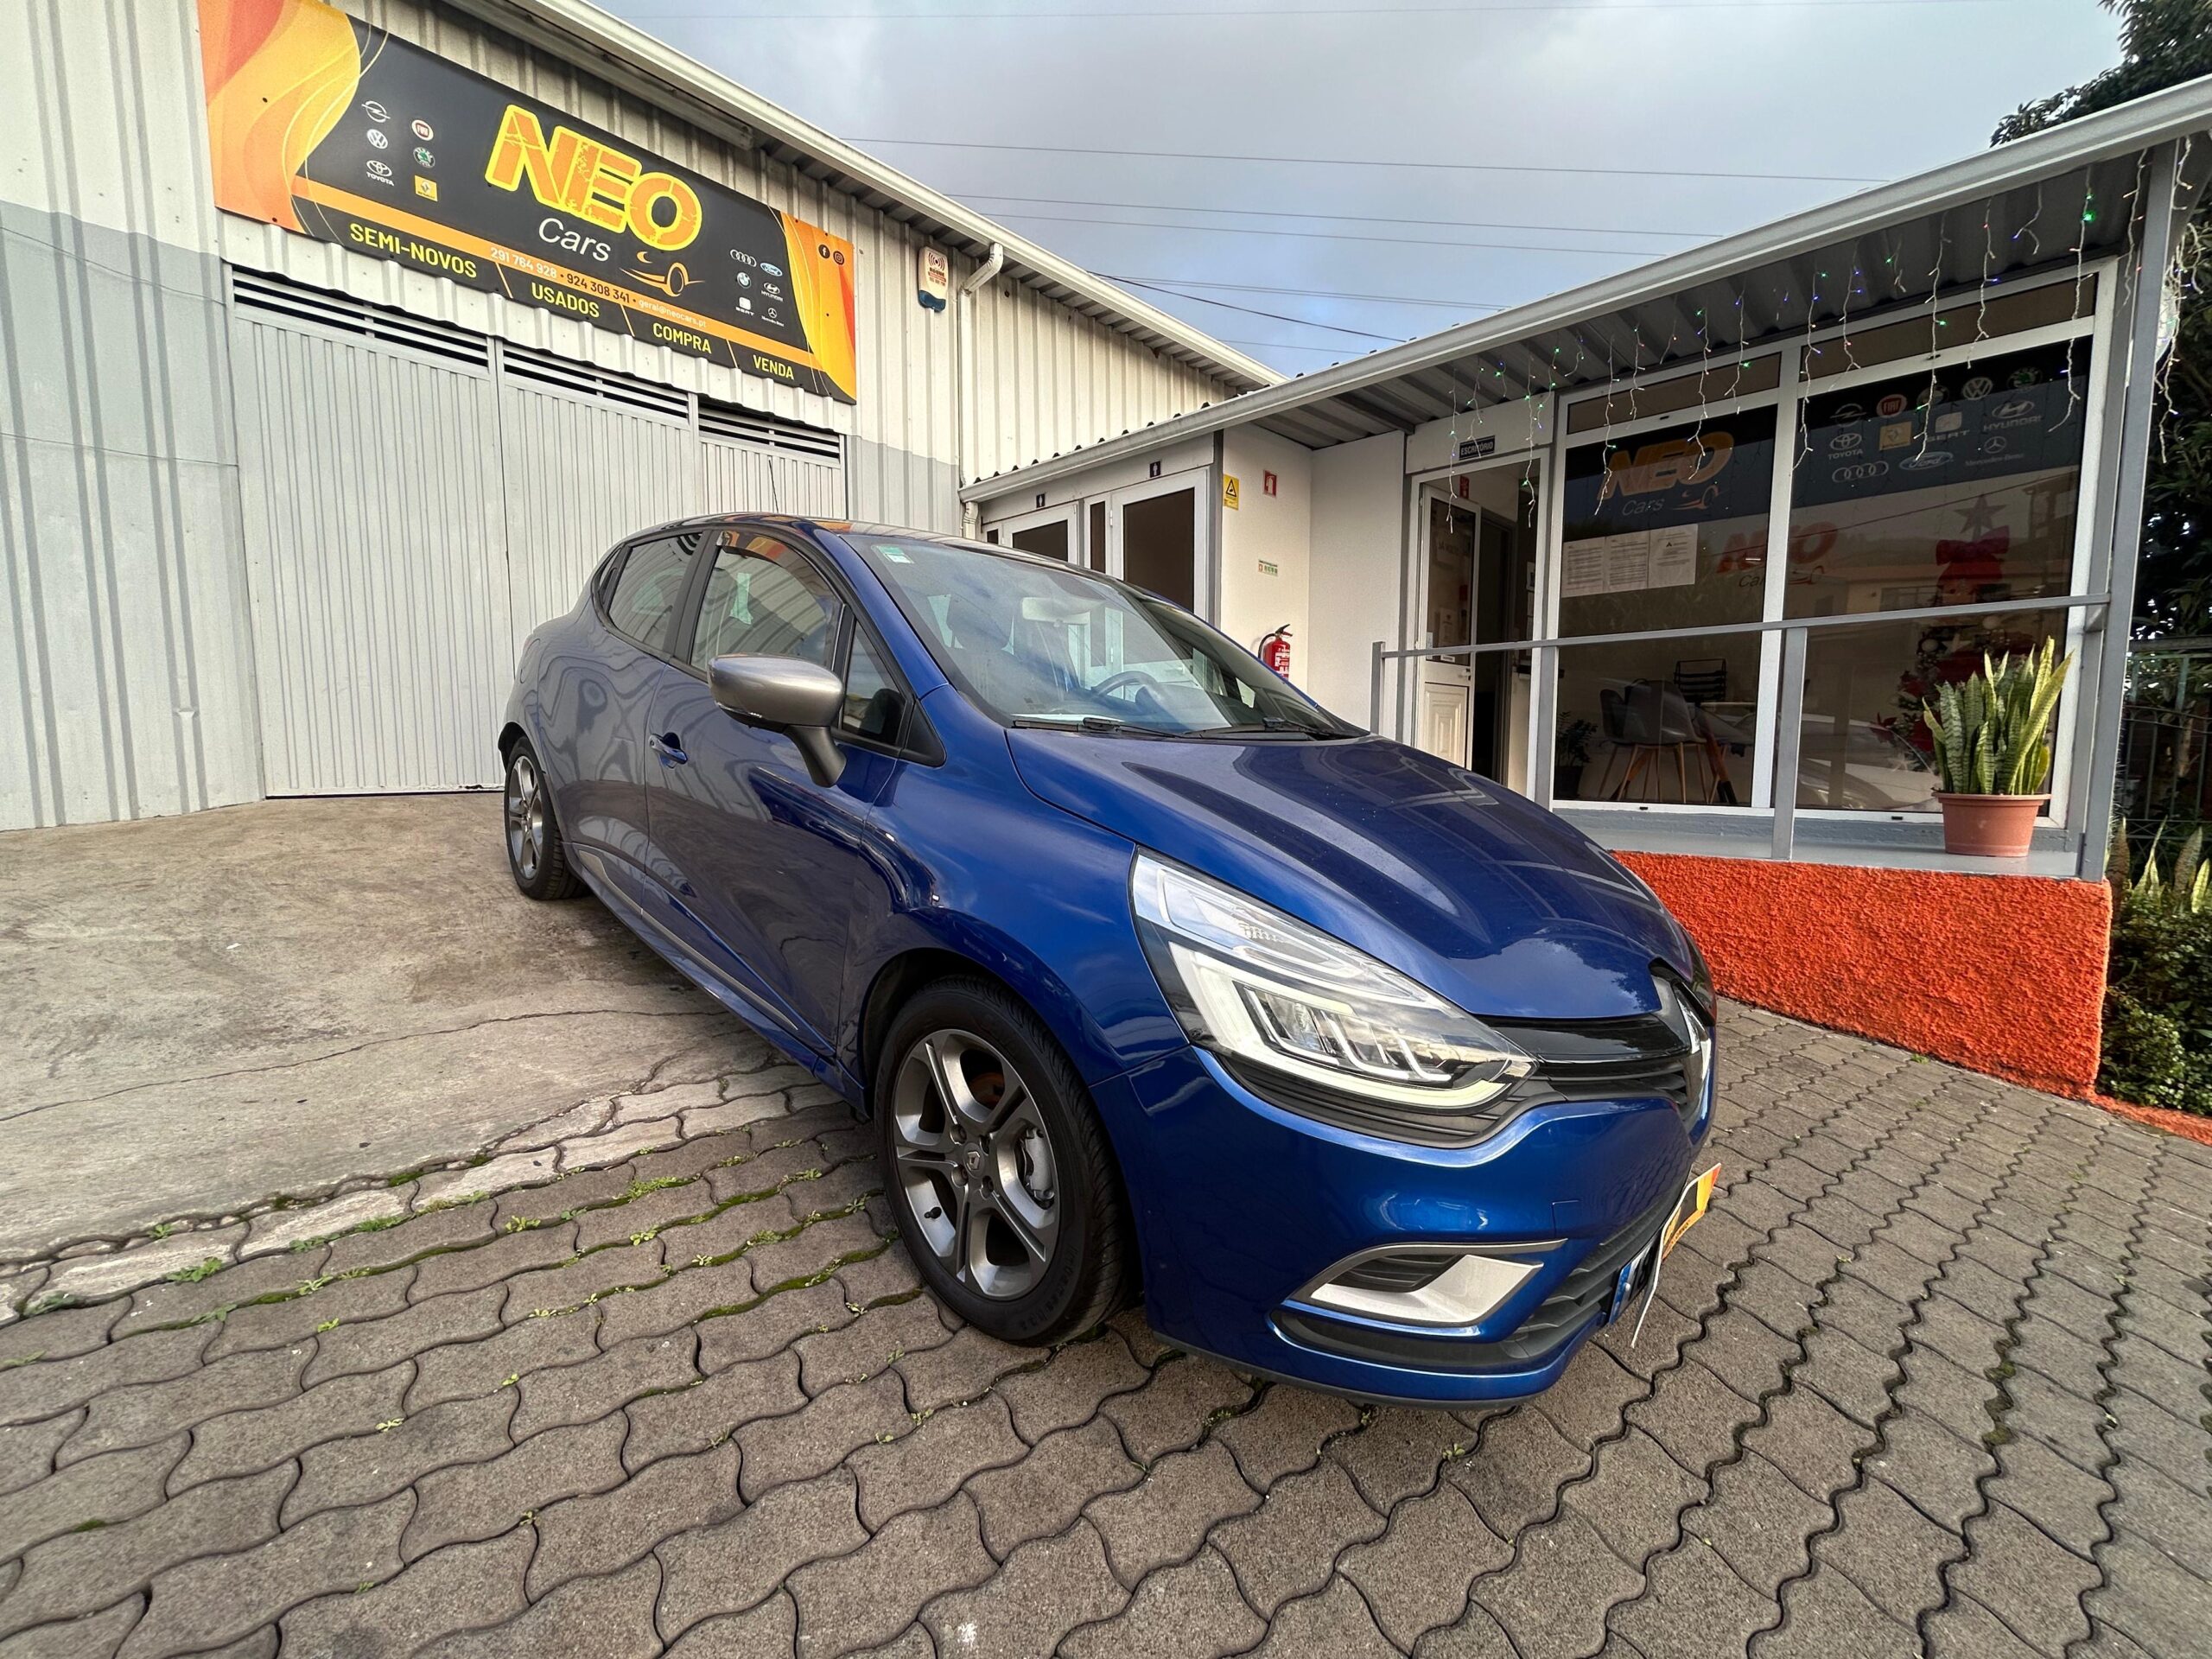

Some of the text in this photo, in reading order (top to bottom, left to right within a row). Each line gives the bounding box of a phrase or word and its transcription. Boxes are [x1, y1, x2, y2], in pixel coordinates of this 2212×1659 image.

[366, 172, 395, 187] TOYOTA
[485, 104, 702, 251] NEO
[350, 223, 477, 278] SEMI-NOVOS
[538, 218, 612, 262] Cars
[491, 247, 706, 327] 291 764 928 924 308 341 geral@neocars.pt
[531, 282, 600, 318] USADOS
[652, 322, 712, 353] COMPRA
[753, 354, 795, 380] VENDA
[1882, 400, 1900, 414] FIAT
[1597, 431, 1735, 500] NEO
[1828, 448, 1863, 460] TOYOTA
[1622, 497, 1665, 516] Cars
